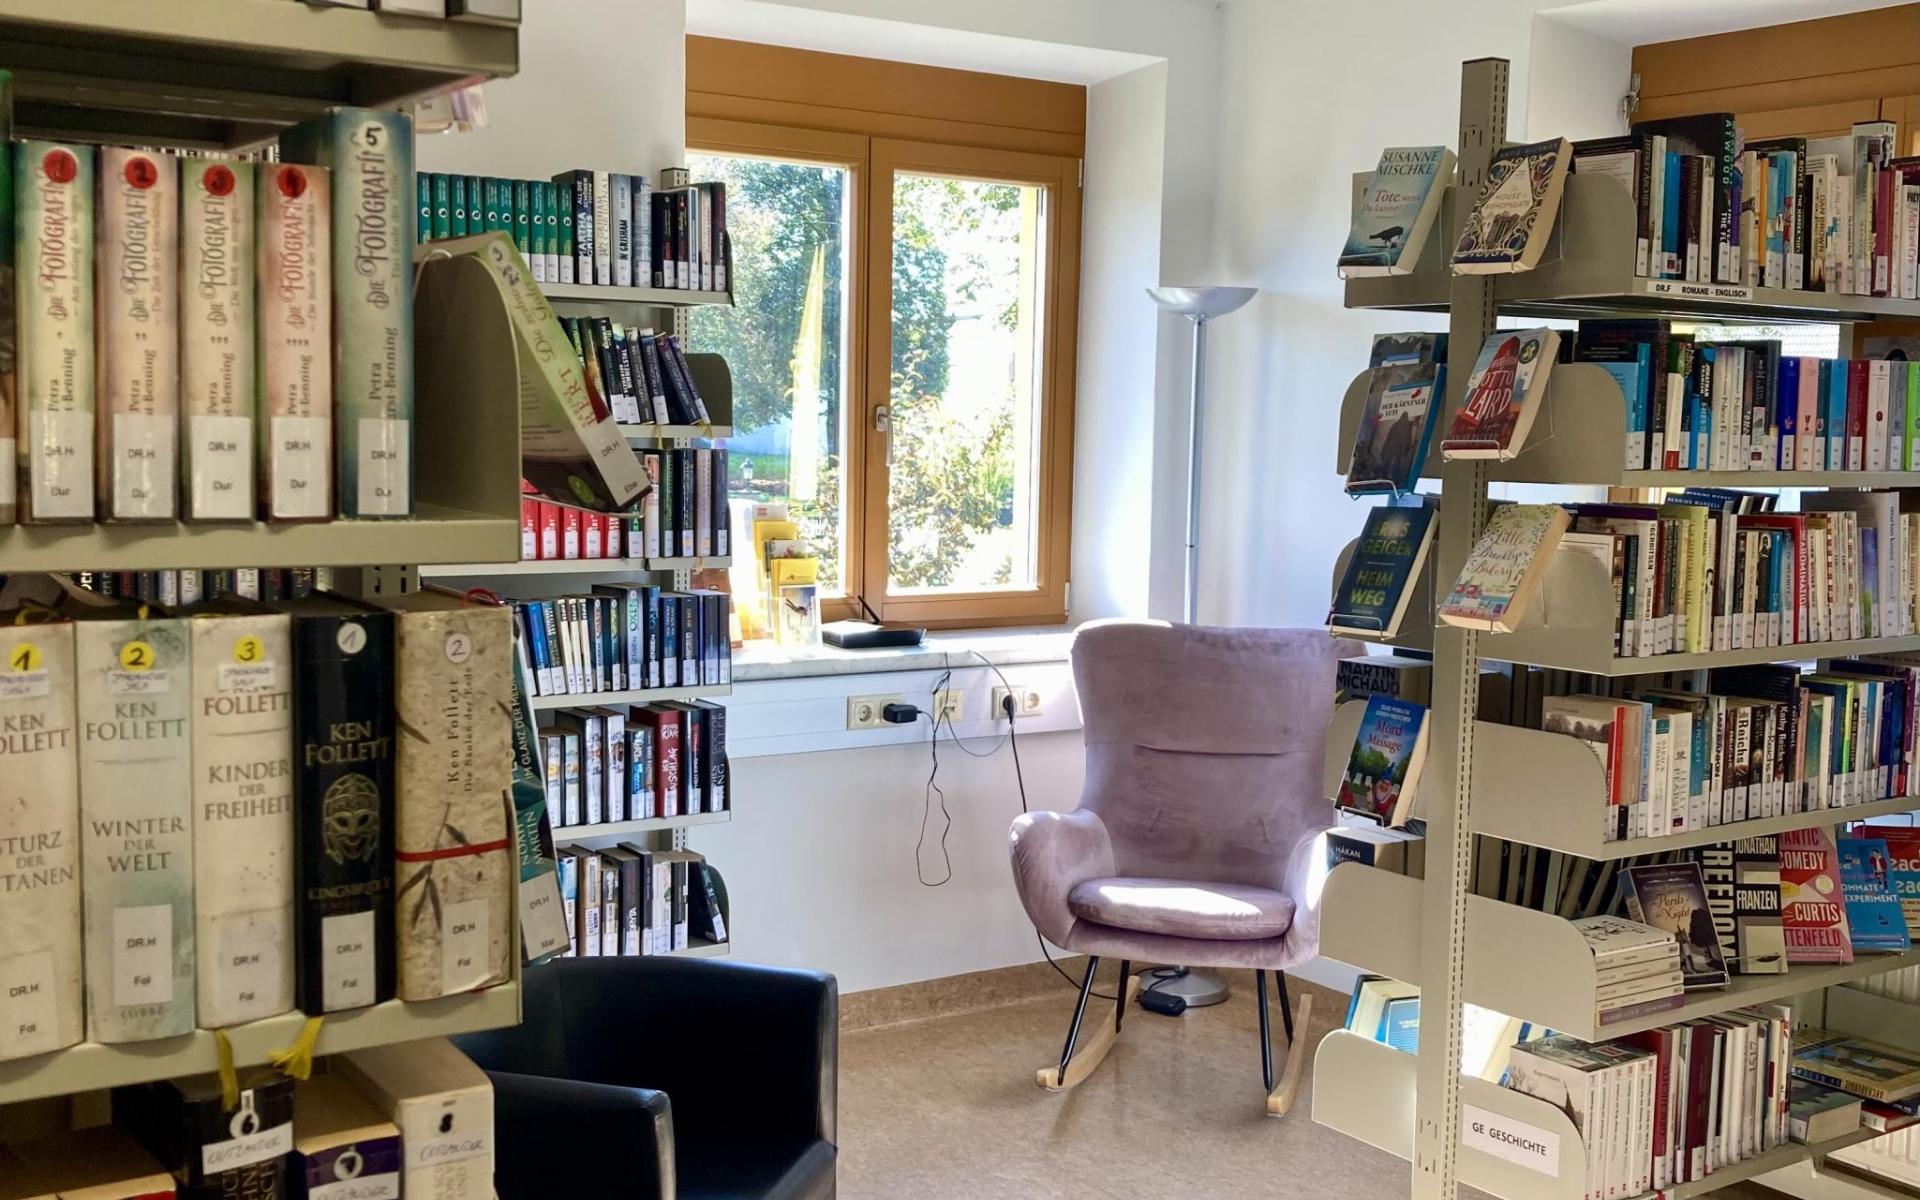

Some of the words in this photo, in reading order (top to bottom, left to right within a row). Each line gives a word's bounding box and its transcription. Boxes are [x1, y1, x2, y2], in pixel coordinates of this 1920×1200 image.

[365, 128, 382, 145] 5
[1381, 150, 1439, 162] SUSANNE
[1722, 120, 1731, 184] ATWOOD
[1377, 162, 1434, 175] MISCHKE
[619, 220, 627, 251] GRISHAM
[1908, 207, 1917, 247] Michael
[1656, 284, 1671, 292] DR.F
[1682, 286, 1709, 295] ROMANE
[1715, 289, 1746, 297] ENGLISCH
[62, 348, 74, 412] t-Benning
[143, 350, 156, 414] t-Benning
[221, 353, 234, 416] t-Benning
[299, 355, 312, 417] t-Benning
[369, 363, 382, 400] Petra
[1480, 370, 1514, 388] OTTO
[48, 379, 59, 412] Petra
[129, 380, 140, 412] Petra
[207, 383, 218, 413] Petra
[287, 384, 297, 415] Petra
[559, 367, 598, 424] BERT
[1464, 388, 1512, 420] LAIRD
[1356, 570, 1394, 587] HEIM
[1350, 588, 1386, 606] WEG
[342, 630, 356, 646] 1
[452, 640, 464, 656] 2
[14, 650, 30, 671] 1
[127, 647, 146, 666] 2
[238, 641, 256, 662] 3
[1340, 663, 1396, 679] MARTIN
[1336, 675, 1400, 695] MICHAUD
[115, 702, 157, 718] KEN
[203, 692, 291, 716] FOLLETT
[443, 679, 459, 740] Follett
[4, 713, 45, 730] KEN
[514, 708, 525, 729] DER
[1778, 706, 1787, 731] Kathy
[86, 719, 185, 741] FOLLETT
[330, 720, 372, 741] KEN
[0, 729, 70, 753] LLETT
[306, 736, 392, 766] FOLLETT
[519, 730, 531, 765] GLANZ
[1737, 720, 1748, 764] Reichs
[1766, 736, 1775, 772] Reichs
[208, 759, 290, 783] KINDER
[447, 750, 459, 783] Ken
[523, 767, 534, 780] IM
[667, 747, 678, 791] NSCHLAG
[239, 783, 265, 797] DER
[464, 771, 472, 792] Die
[204, 795, 292, 821] FREIHEIT
[92, 817, 184, 836] WINTER
[1, 831, 62, 853] TURZ
[124, 839, 155, 850] DER
[525, 810, 544, 865] MARTIN
[1735, 838, 1776, 854] JONATHAN
[1786, 830, 1819, 846] ANTIC
[16, 855, 44, 868] DER
[107, 852, 171, 872] WELT
[1335, 845, 1361, 858] HÅKAN
[1780, 852, 1824, 870] COMEDY
[0, 865, 73, 892] TANEN
[1736, 890, 1777, 910] FRANZEN
[1794, 903, 1839, 921] CURTIS
[1784, 929, 1840, 946] TTENFELD
[1749, 1040, 1757, 1073] 1517
[242, 1115, 255, 1134] 6
[1472, 1122, 1485, 1134] GE
[1489, 1128, 1546, 1156] GESCHICHTE
